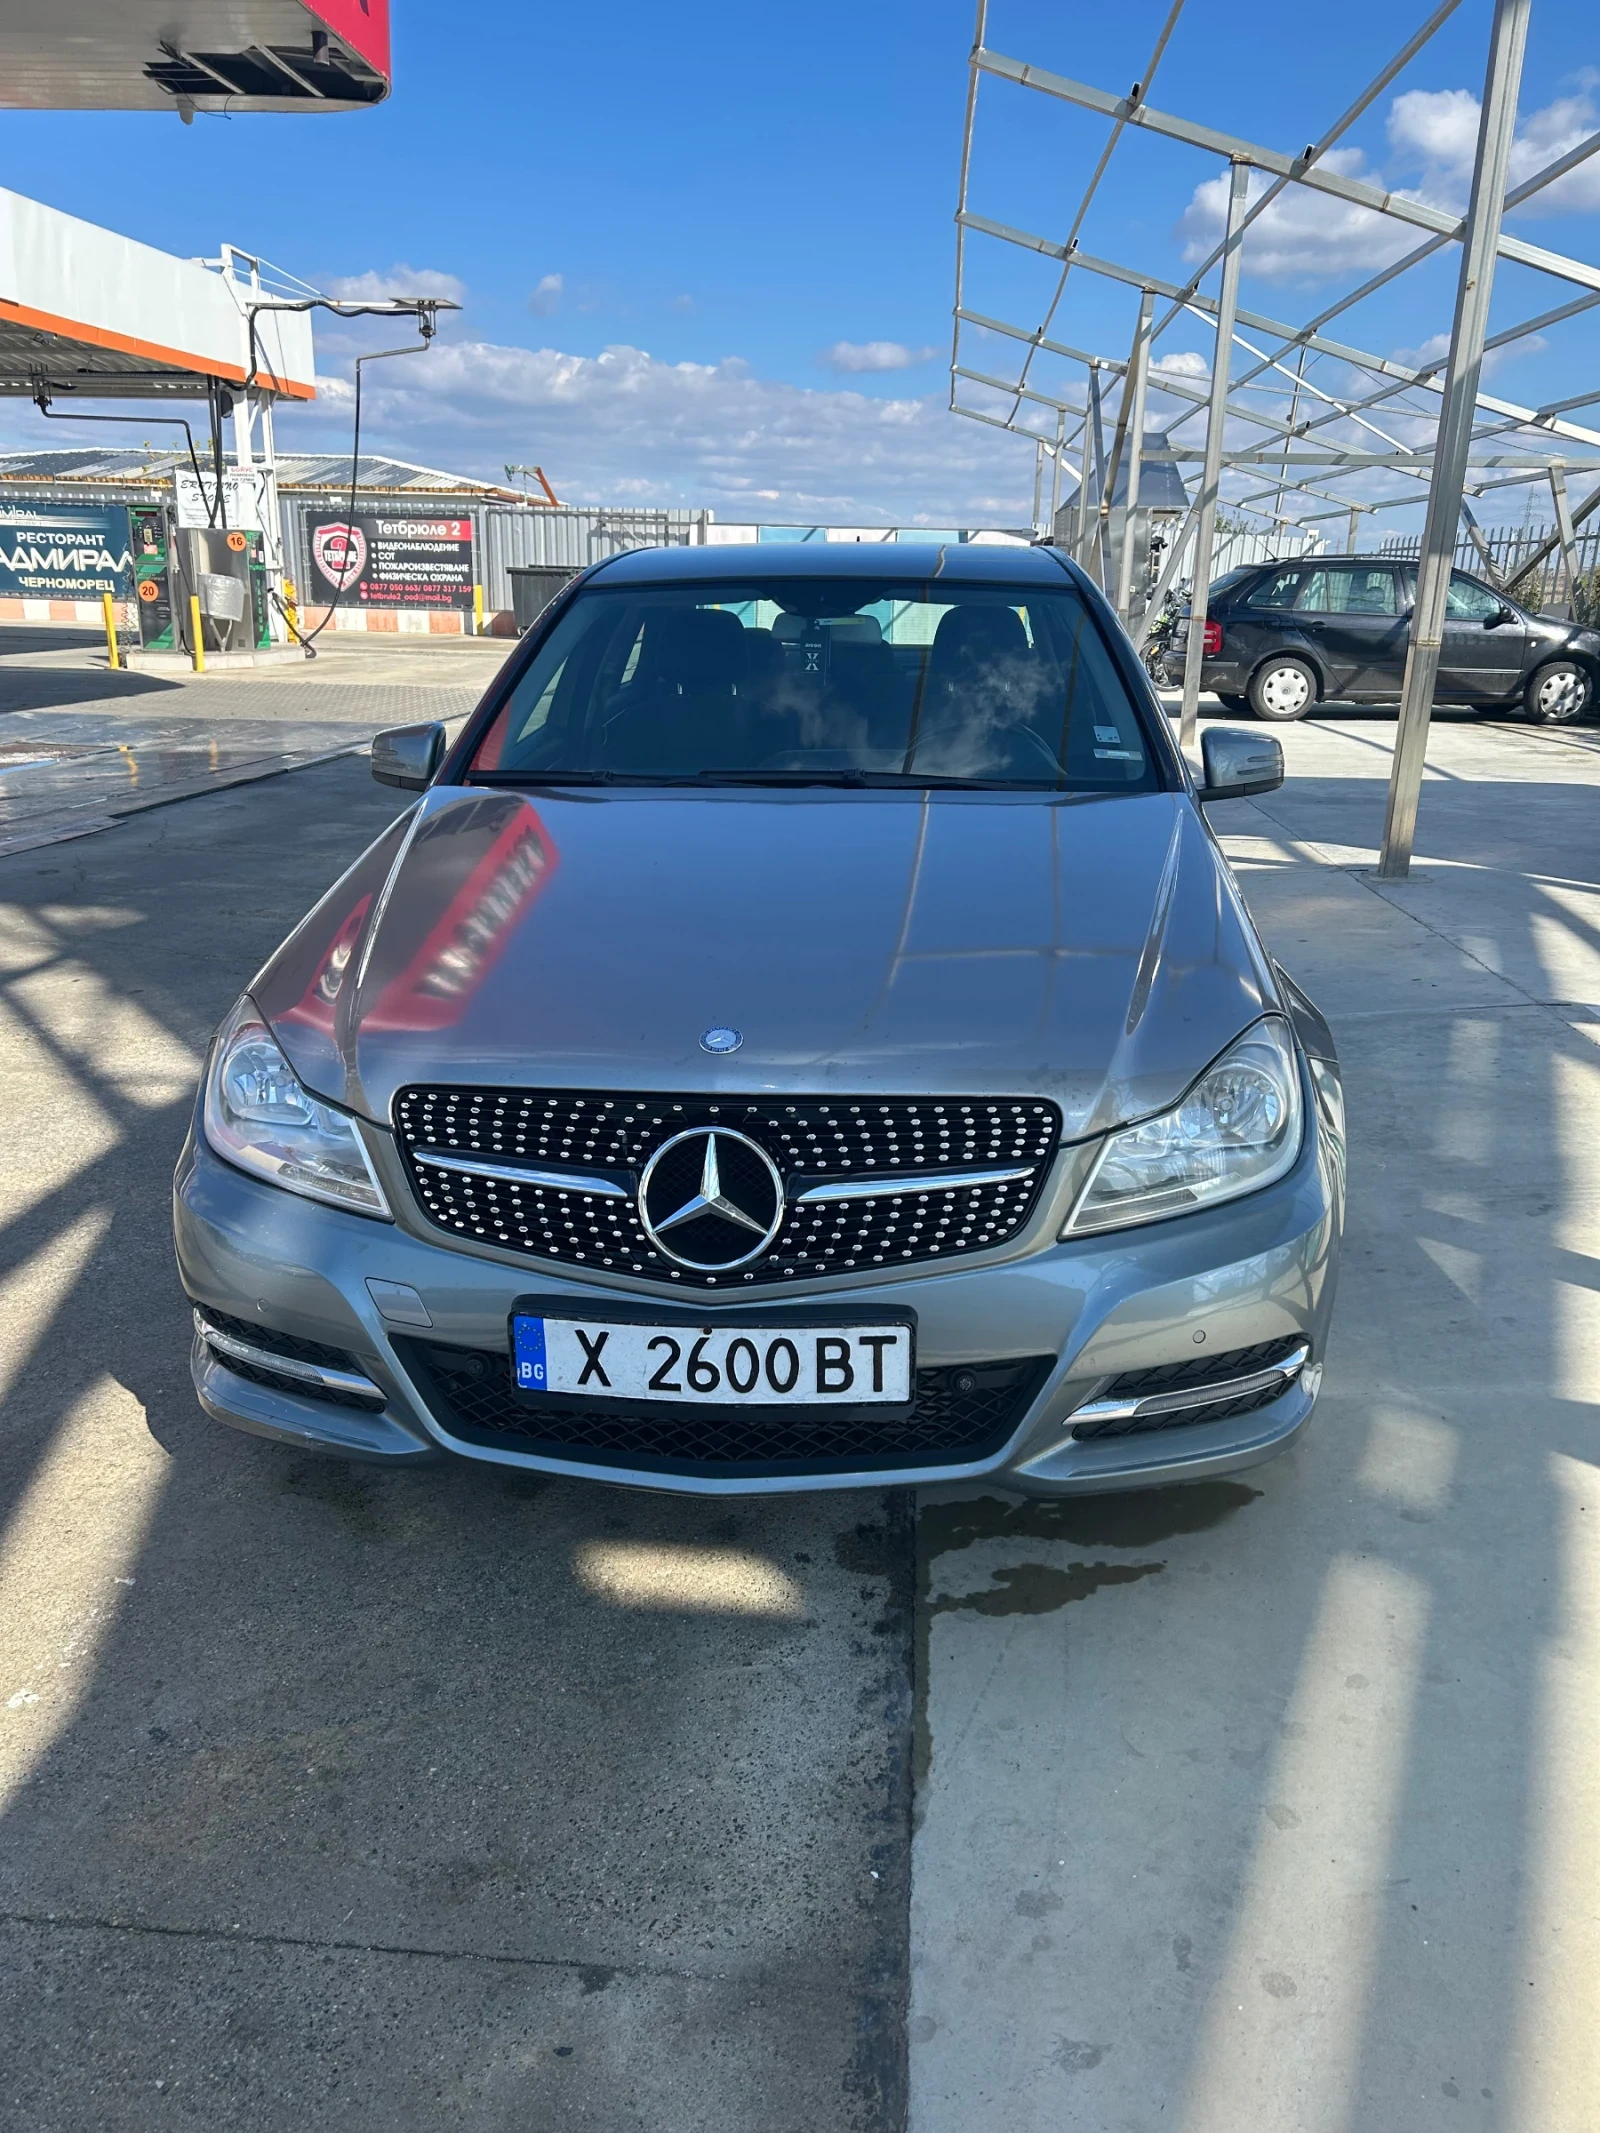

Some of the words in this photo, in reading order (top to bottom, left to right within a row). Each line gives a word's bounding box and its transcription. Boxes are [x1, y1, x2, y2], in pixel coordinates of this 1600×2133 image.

[191, 493, 231, 503] STOE
[375, 520, 447, 538] Тетбрюле
[451, 521, 461, 536] 2
[16, 531, 106, 546] РЕСТОРАНТ
[230, 536, 243, 546] 16
[377, 541, 460, 552] ВИДЕОНАБЛЮДЕНИЕ
[378, 552, 396, 560] СОТ
[379, 562, 470, 573] ПОЖАРОИЗВЕСТЯВАНЕ
[379, 572, 429, 582] ФИЗИЧЕСКА
[430, 573, 464, 582] ОХРАНА
[18, 576, 116, 592] ЧЕРНОМОРЕЦ
[370, 583, 388, 591] 0877
[423, 584, 441, 592] 0877
[142, 586, 155, 596] 20
[574, 1329, 612, 1387] X
[646, 1335, 800, 1394] 2600
[816, 1335, 898, 1394] BT
[521, 1361, 545, 1380] BG
